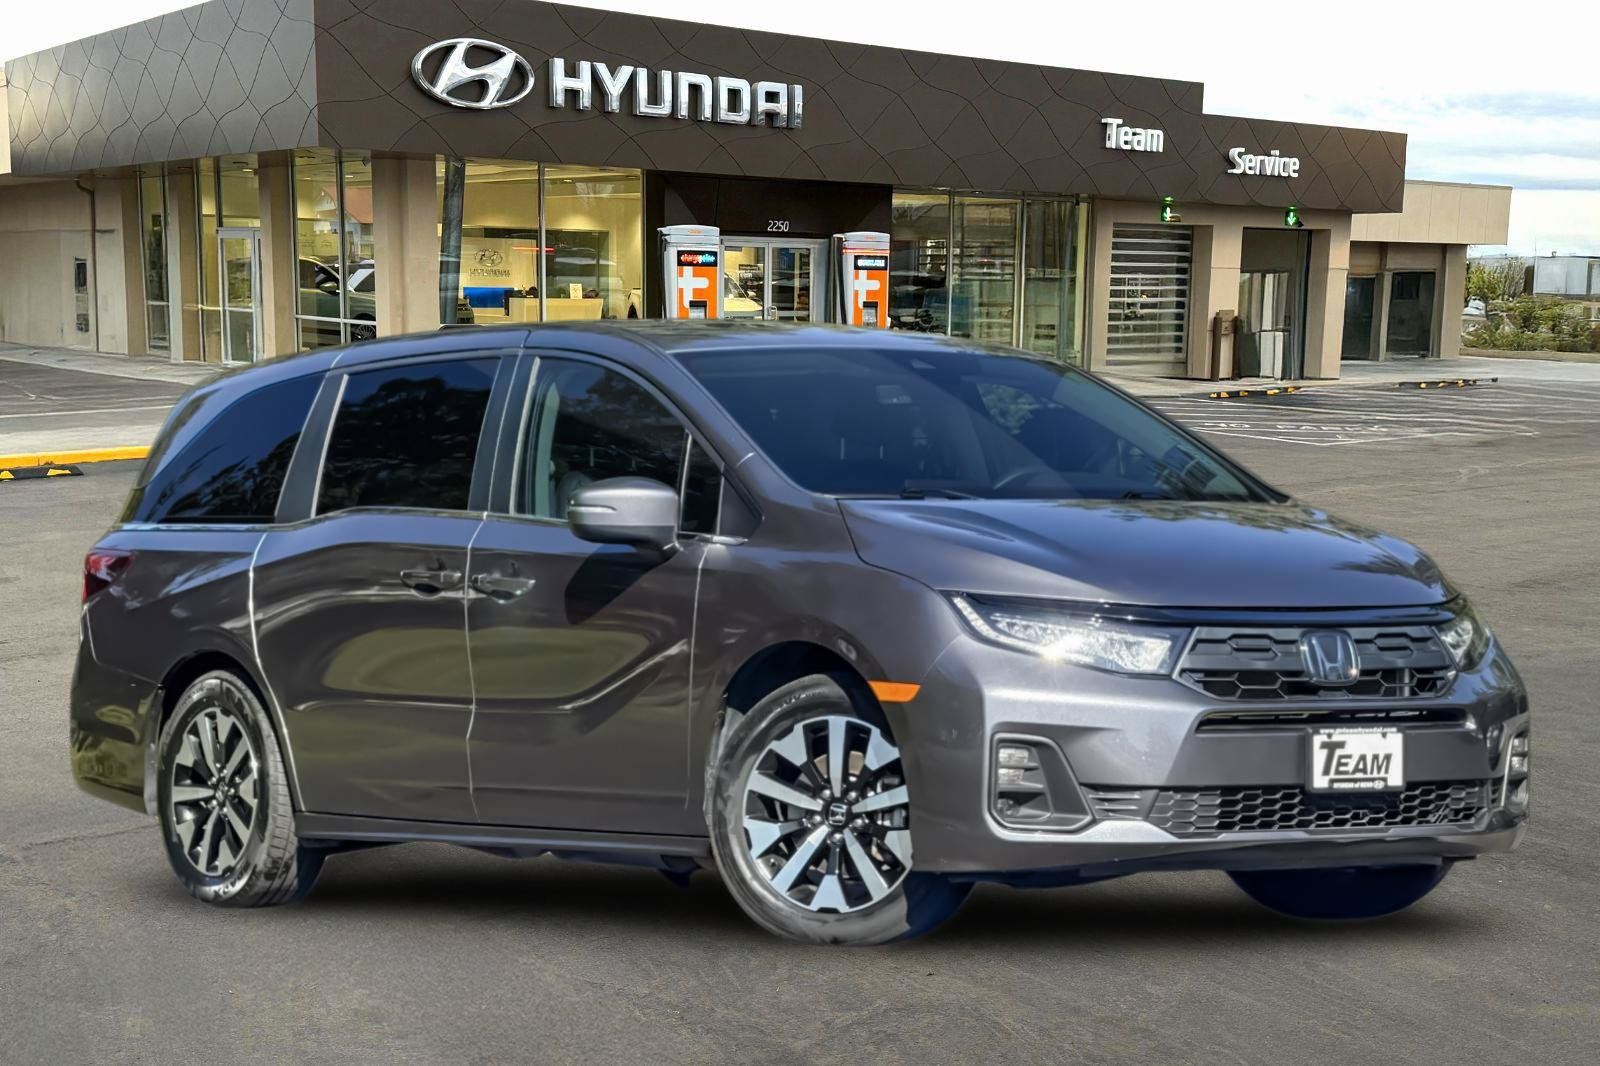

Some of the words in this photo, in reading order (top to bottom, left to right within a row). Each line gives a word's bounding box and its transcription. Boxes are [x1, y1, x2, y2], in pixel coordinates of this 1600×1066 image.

[549, 57, 803, 129] HYUNDAI
[1101, 117, 1164, 152] Team
[1227, 147, 1300, 178] Service
[767, 220, 790, 232] 2250
[1319, 741, 1393, 776] TEAM
